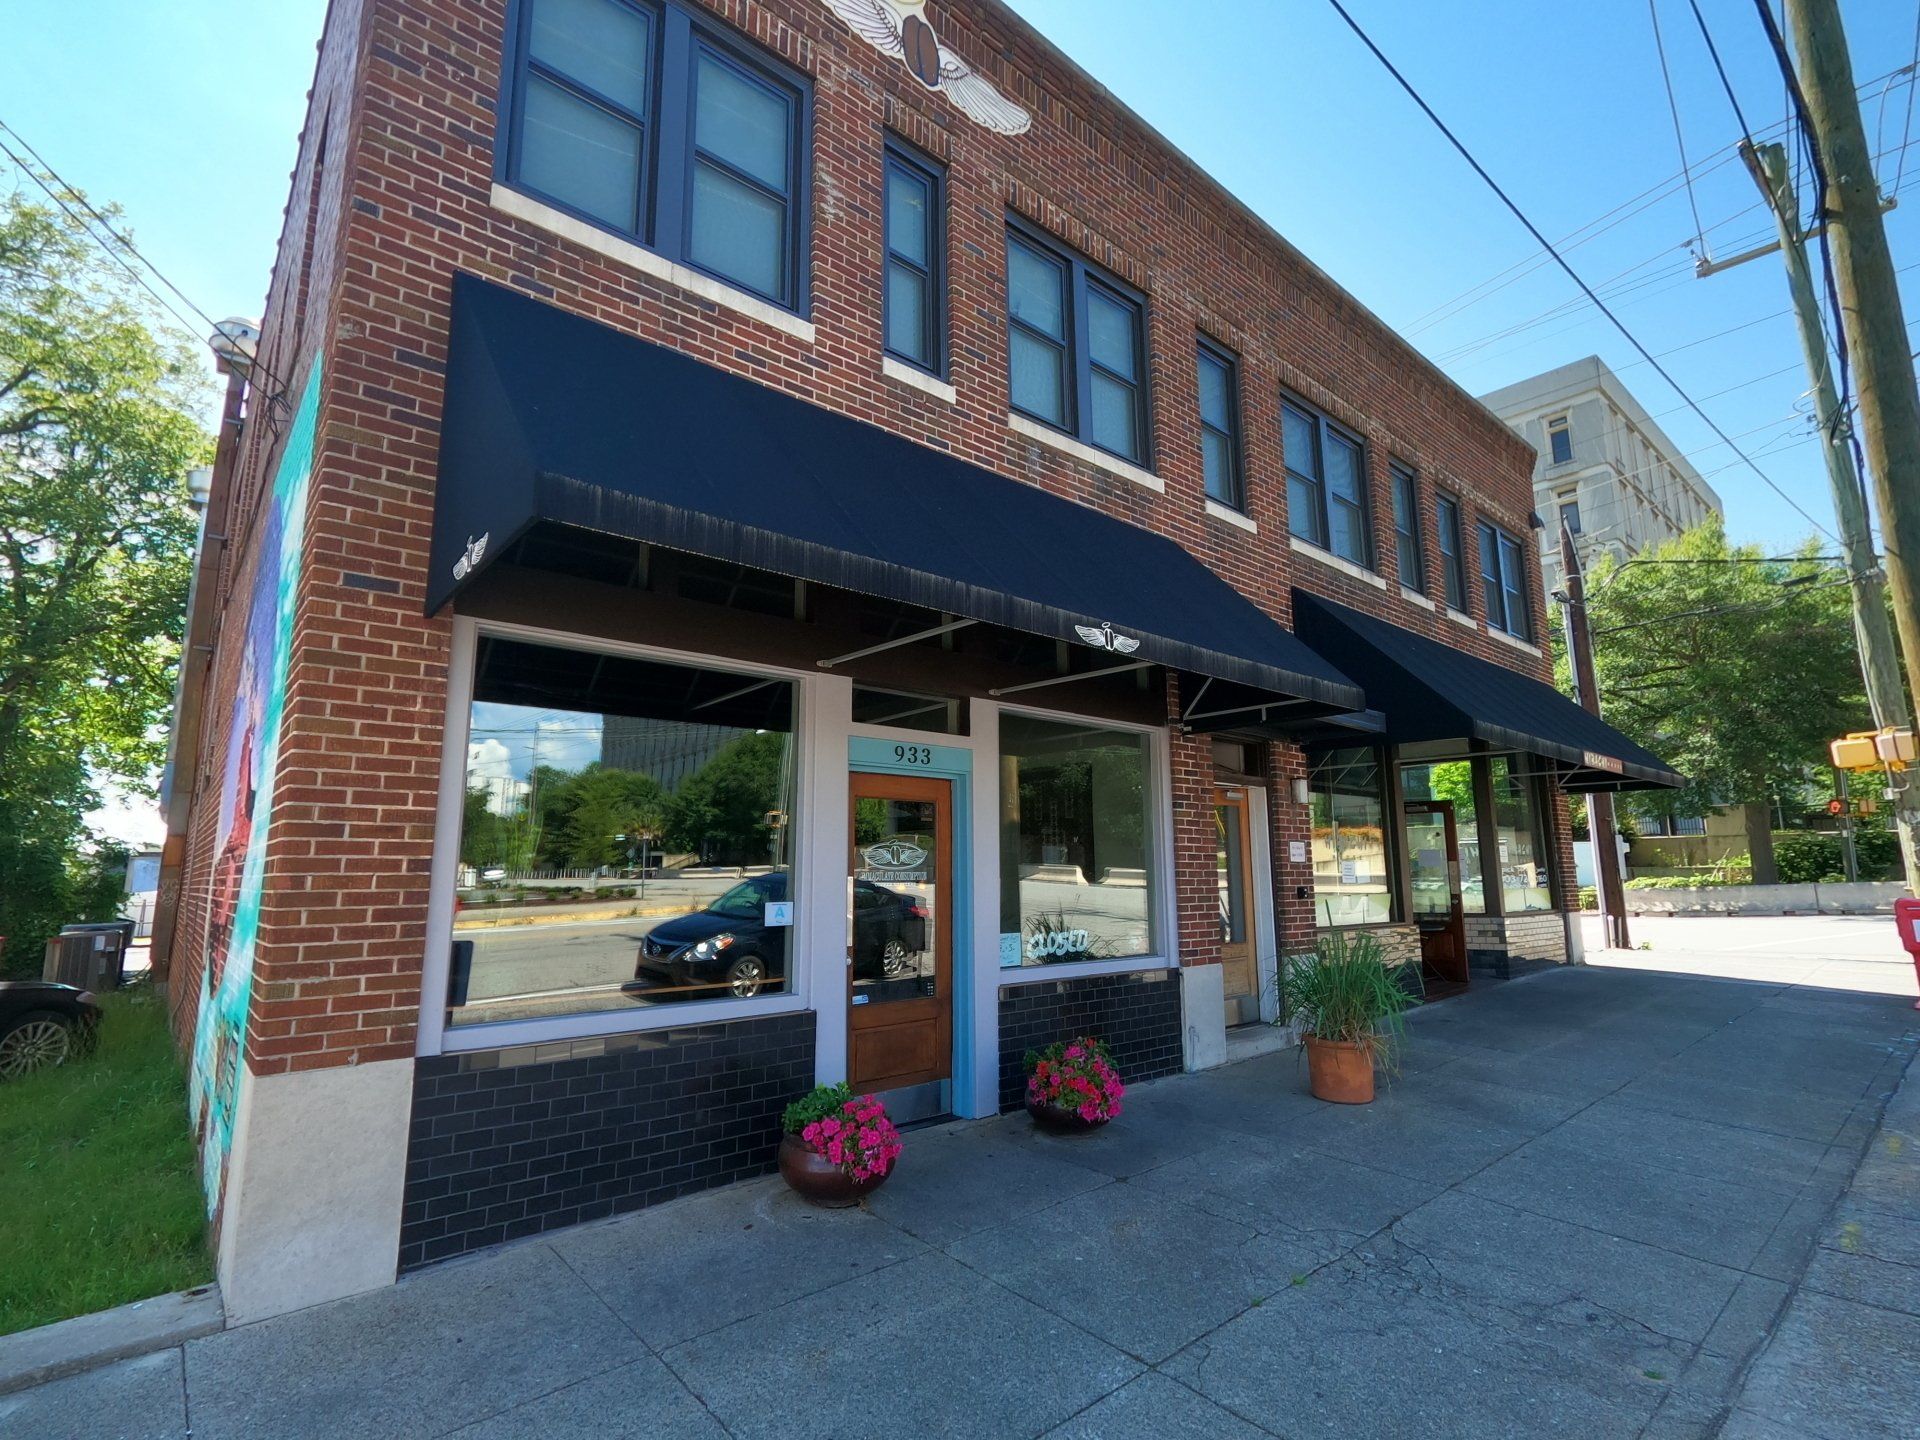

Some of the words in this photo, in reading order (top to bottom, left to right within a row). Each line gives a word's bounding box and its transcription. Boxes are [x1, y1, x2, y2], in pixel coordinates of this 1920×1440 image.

[894, 745, 931, 765] 933
[775, 906, 785, 918] A
[1027, 929, 1089, 959] CLOSED
